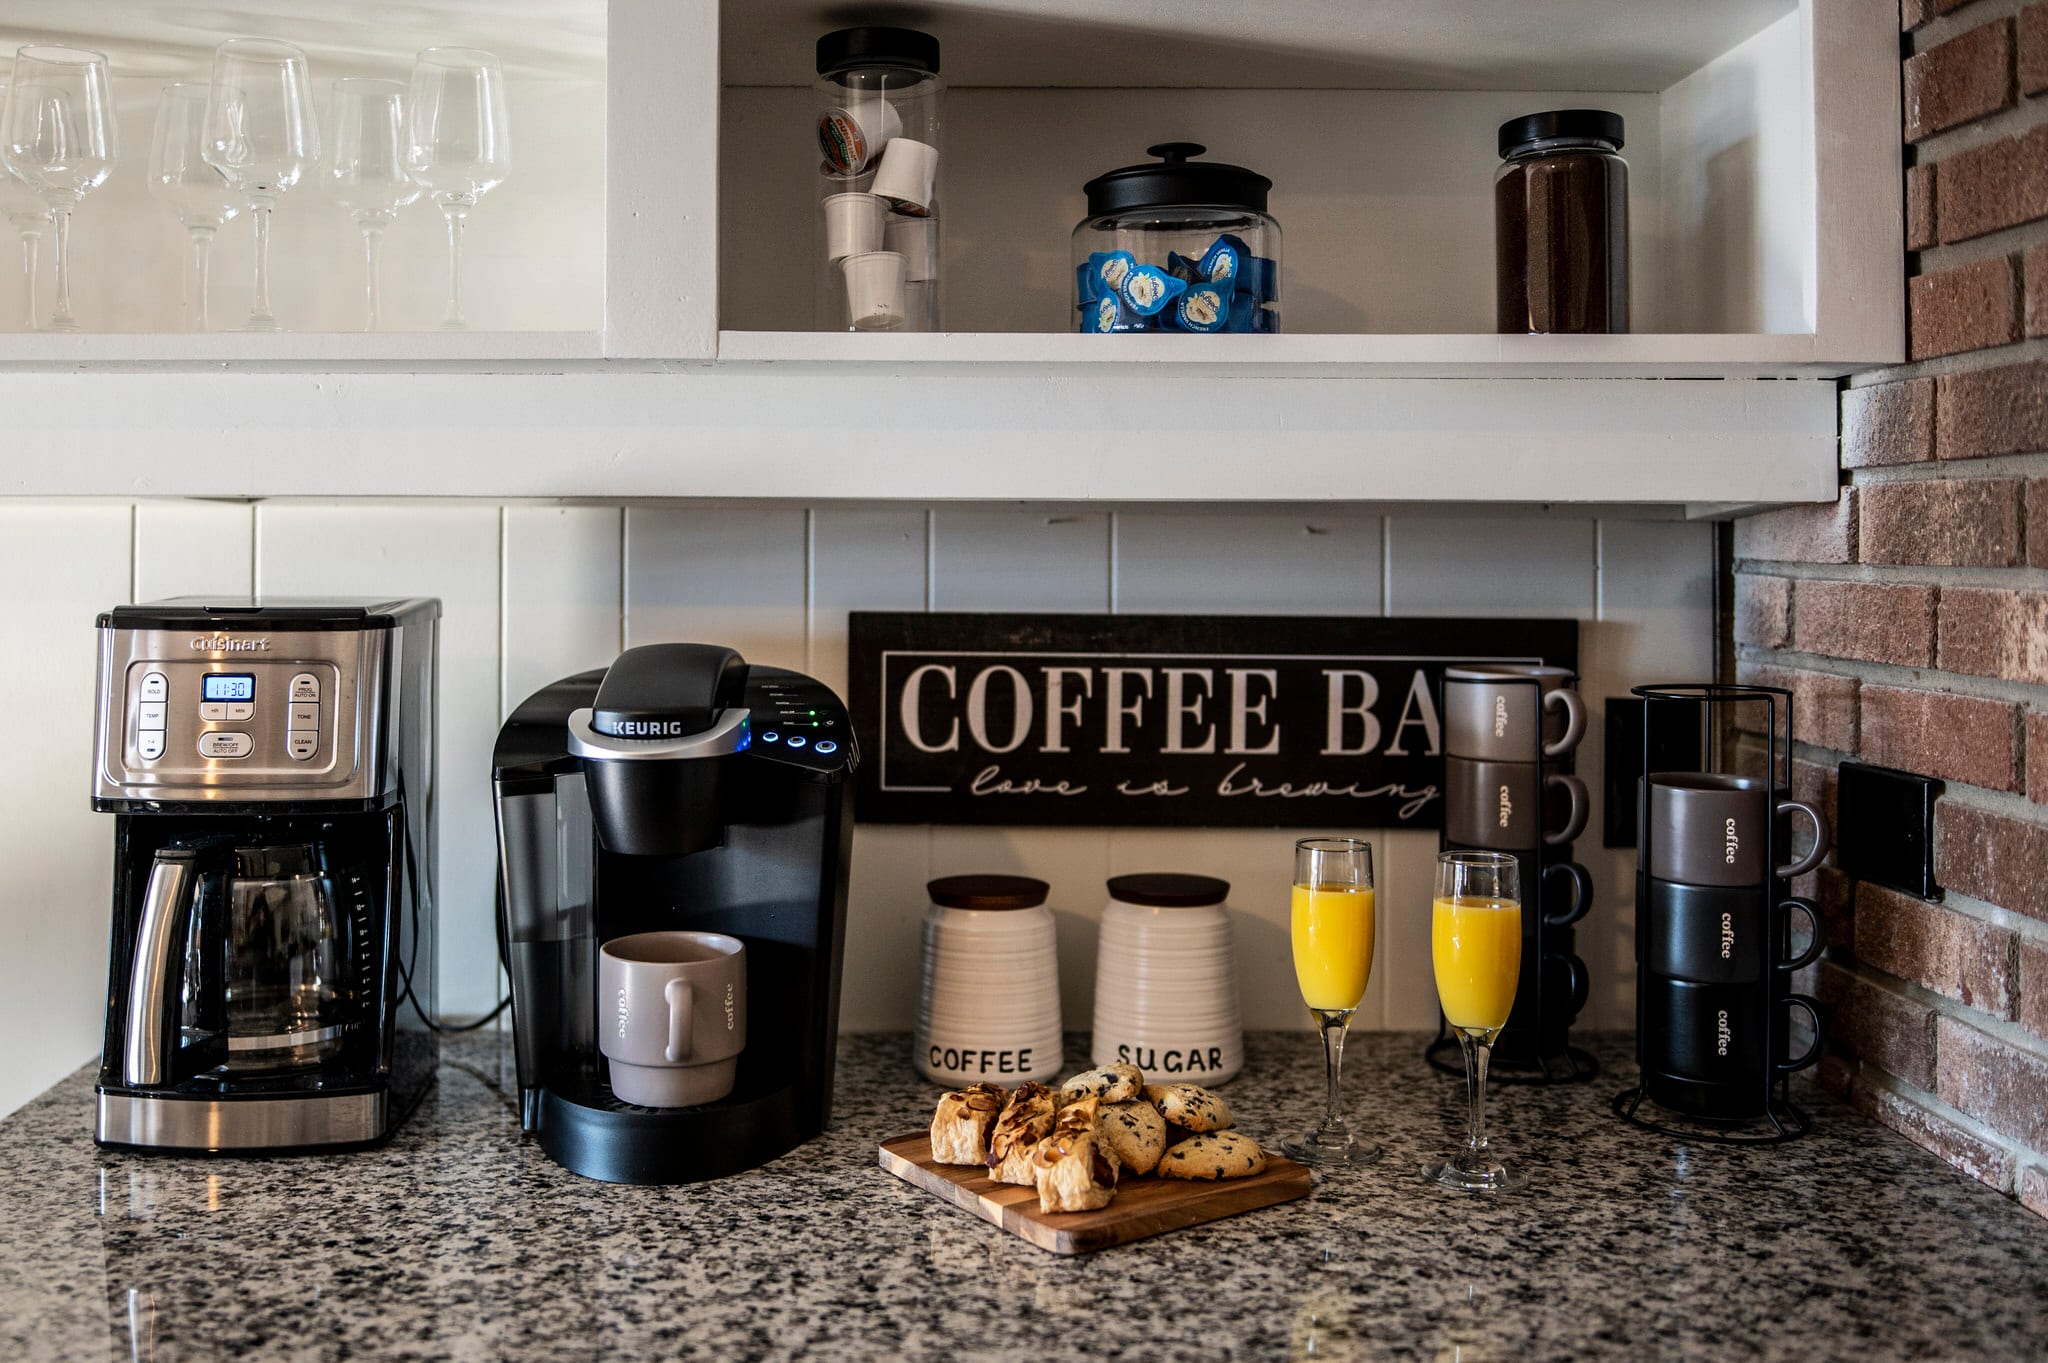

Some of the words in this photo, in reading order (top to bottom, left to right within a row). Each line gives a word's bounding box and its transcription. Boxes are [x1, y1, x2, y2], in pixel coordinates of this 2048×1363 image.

[190, 636, 270, 651] Cuisinart
[216, 682, 245, 697] 11:30
[900, 665, 1281, 755] COFFEE
[613, 721, 681, 735] KEURIG
[1495, 695, 1505, 738] coffee
[970, 764, 1087, 797] love
[1117, 778, 1190, 798] is
[1218, 763, 1441, 820] brewing
[1500, 785, 1513, 828] coffee
[1725, 818, 1735, 865] coffee
[1721, 912, 1732, 960] coffee
[617, 988, 630, 1039] coffee
[724, 983, 734, 1030] coffee
[1717, 1010, 1728, 1057] coffee
[929, 1045, 1033, 1074] COFFEE
[1117, 1044, 1224, 1073] SUGAR
